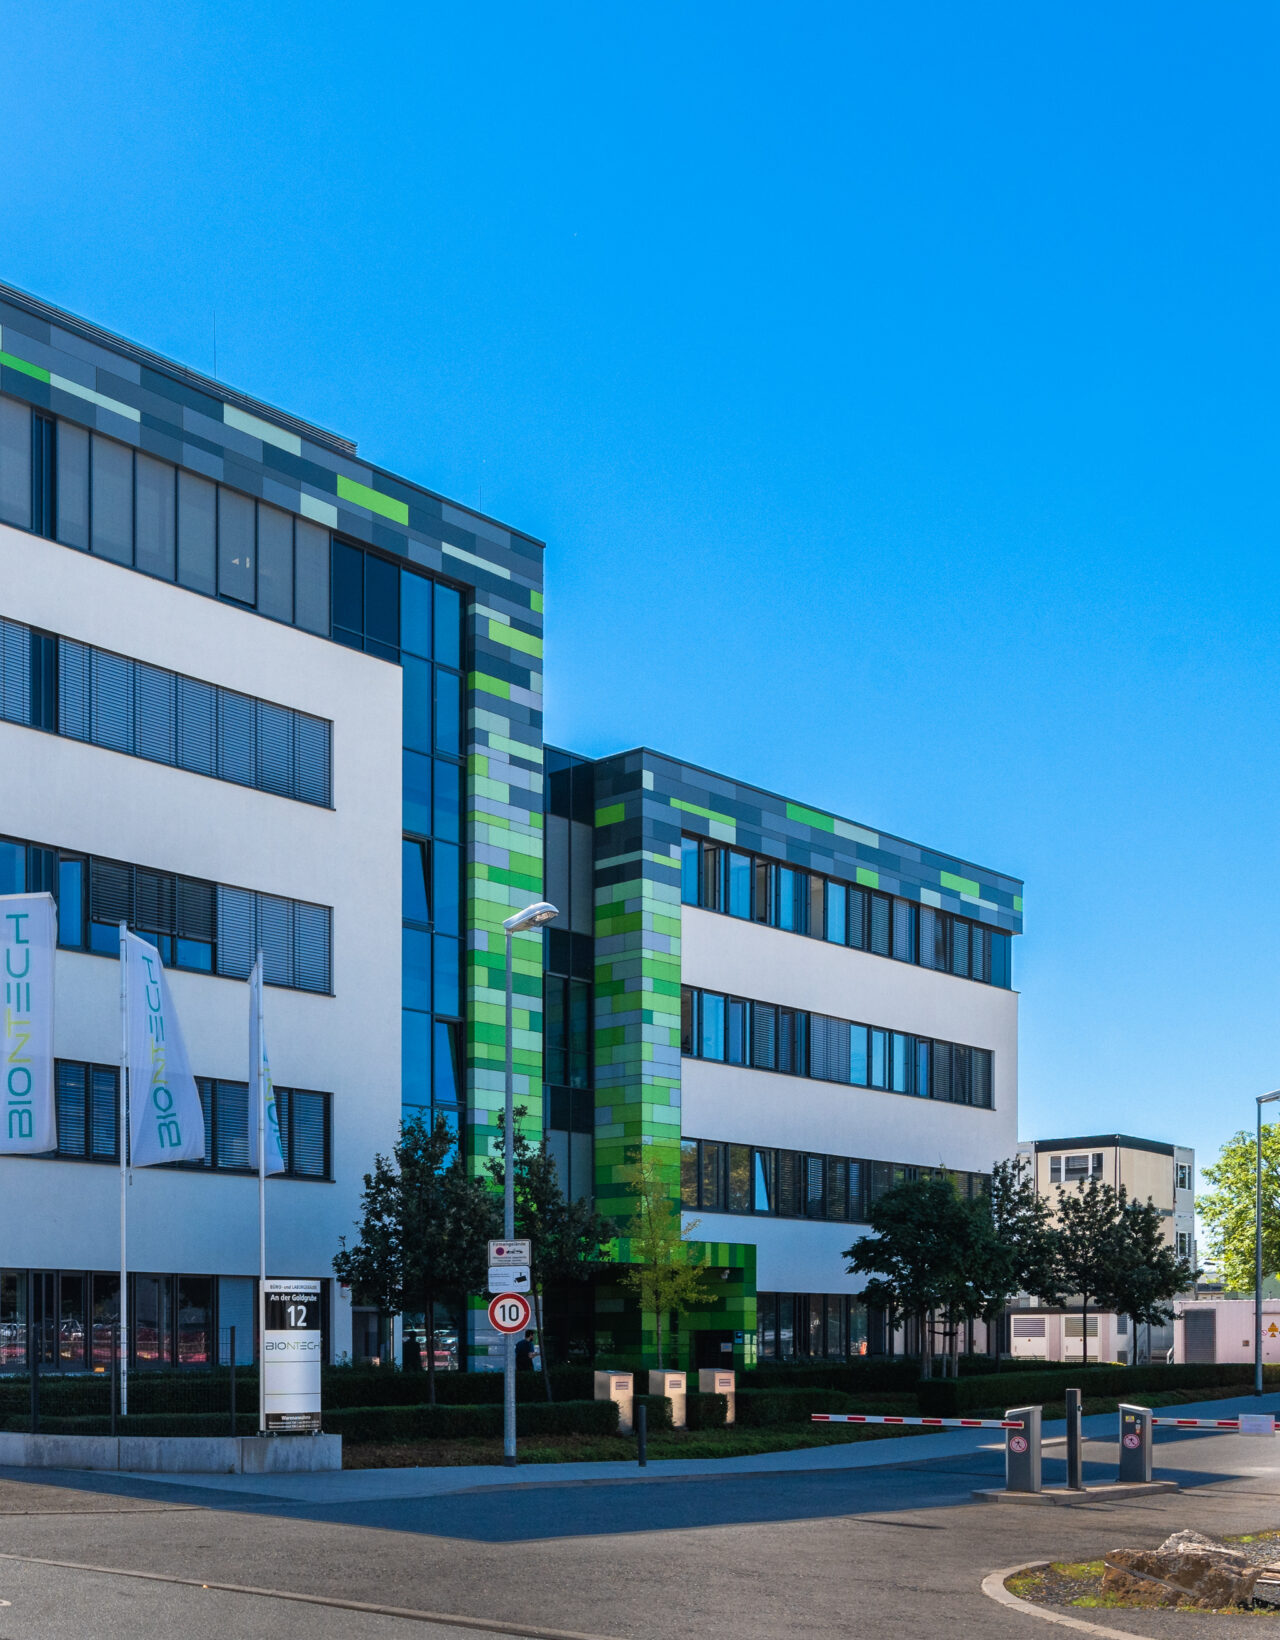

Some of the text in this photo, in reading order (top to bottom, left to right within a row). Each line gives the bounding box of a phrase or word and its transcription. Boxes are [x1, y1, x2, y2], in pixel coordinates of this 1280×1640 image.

[5, 913, 33, 1139] BIONTECH
[141, 955, 182, 1149] BIONTECH
[280, 1293, 291, 1301] der
[291, 1294, 317, 1303] Goldgrube
[287, 1305, 307, 1327] 12
[499, 1304, 520, 1322] 10
[265, 1341, 320, 1351] BIONTECH
